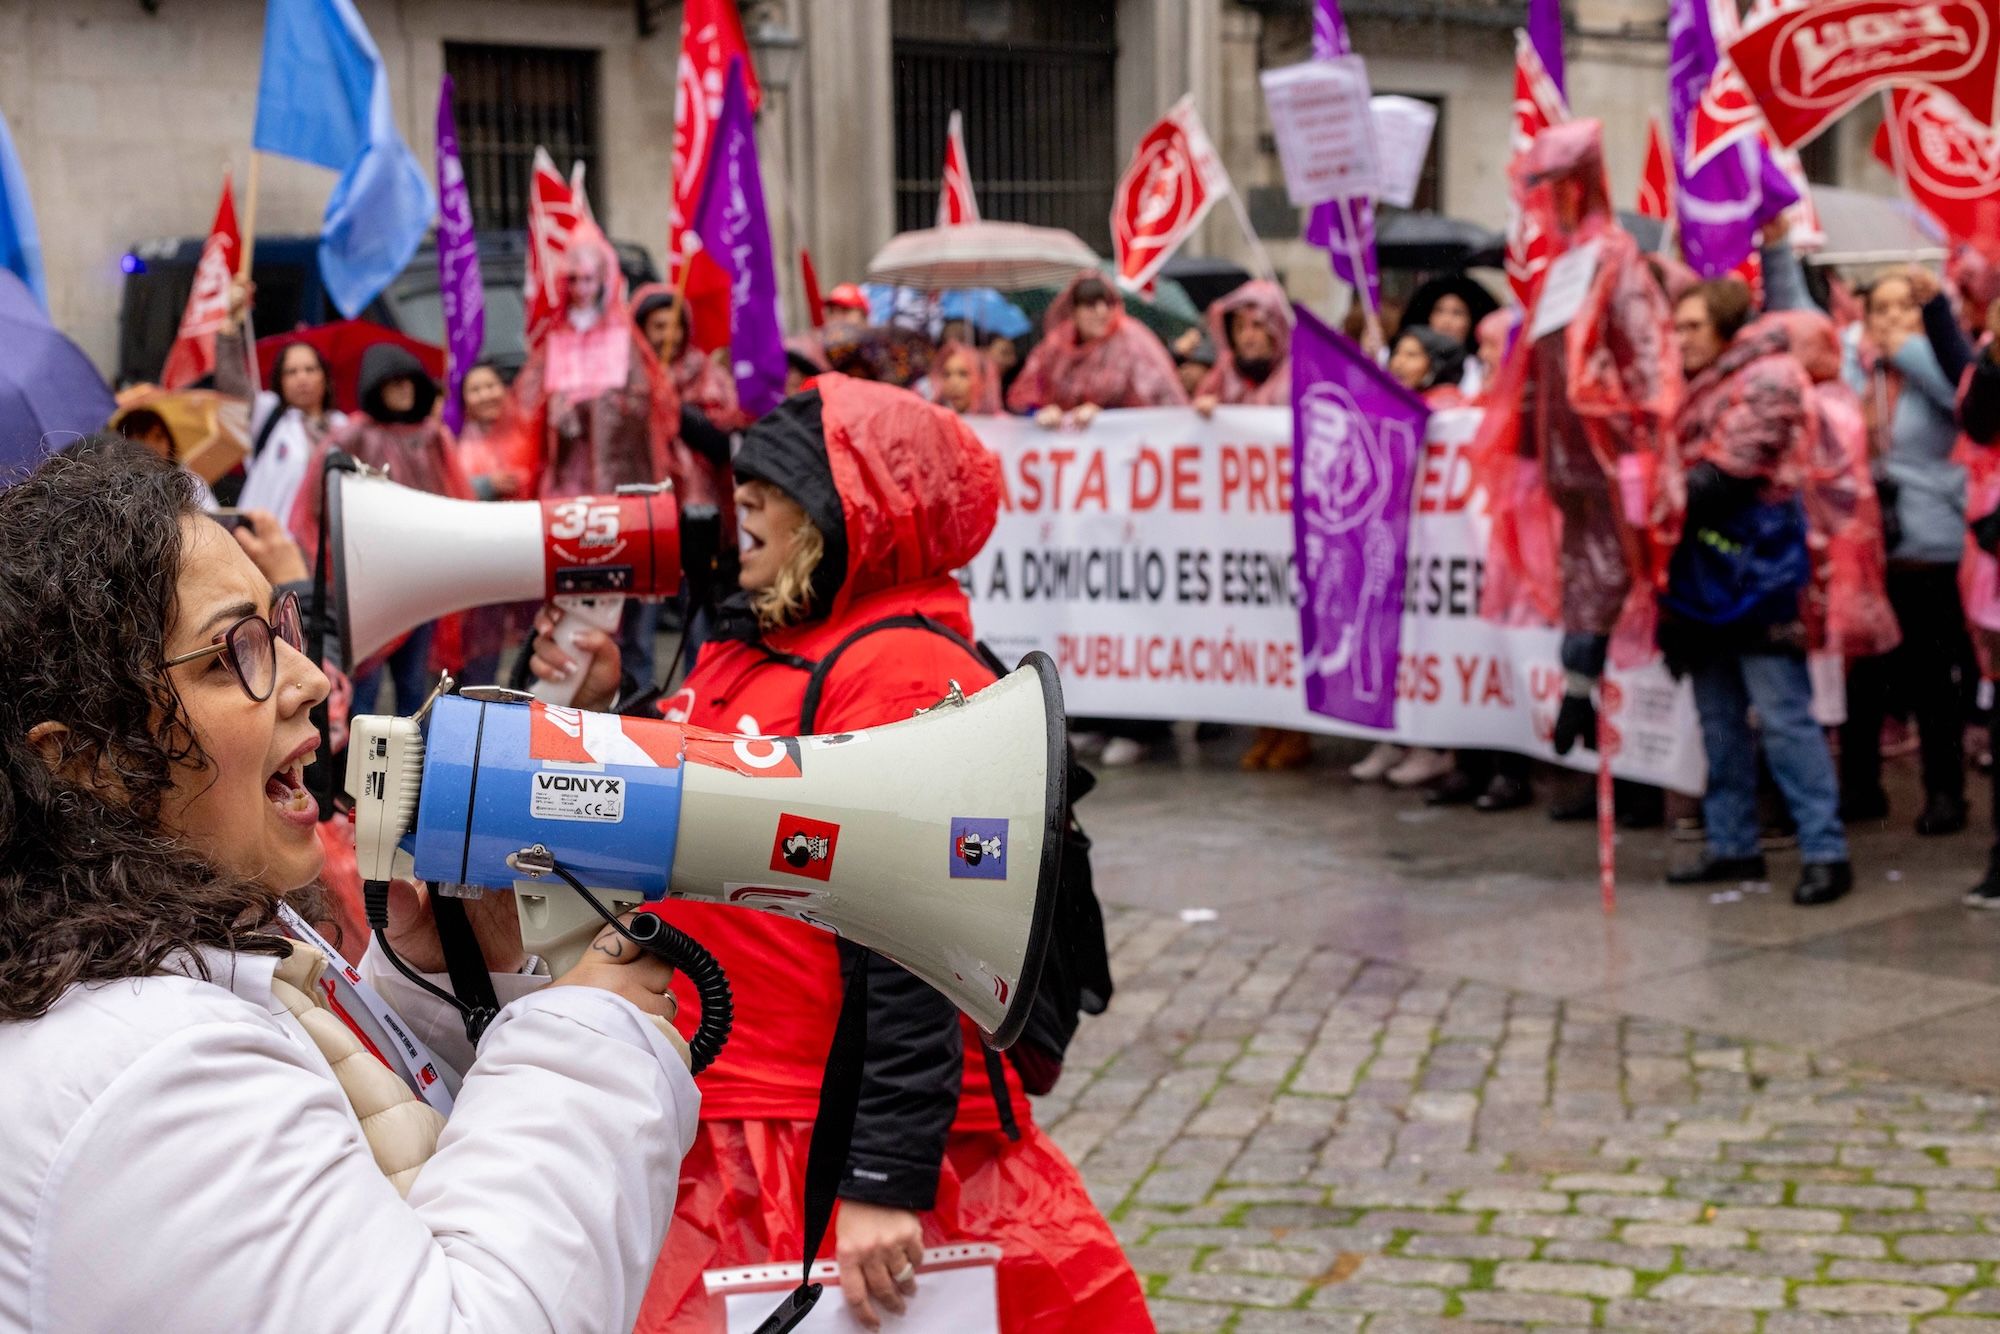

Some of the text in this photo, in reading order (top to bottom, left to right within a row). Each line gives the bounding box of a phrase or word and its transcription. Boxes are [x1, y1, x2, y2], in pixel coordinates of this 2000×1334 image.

[1130, 445, 1202, 513] DE
[551, 502, 620, 540] 35
[987, 549, 1010, 600] A
[1176, 549, 1210, 603] ES
[1057, 627, 1257, 685] PUBLICACIÓN
[1264, 640, 1297, 689] DE
[370, 735, 377, 745] ON
[365, 773, 373, 796] VOLUME
[538, 775, 620, 795] VONYX
